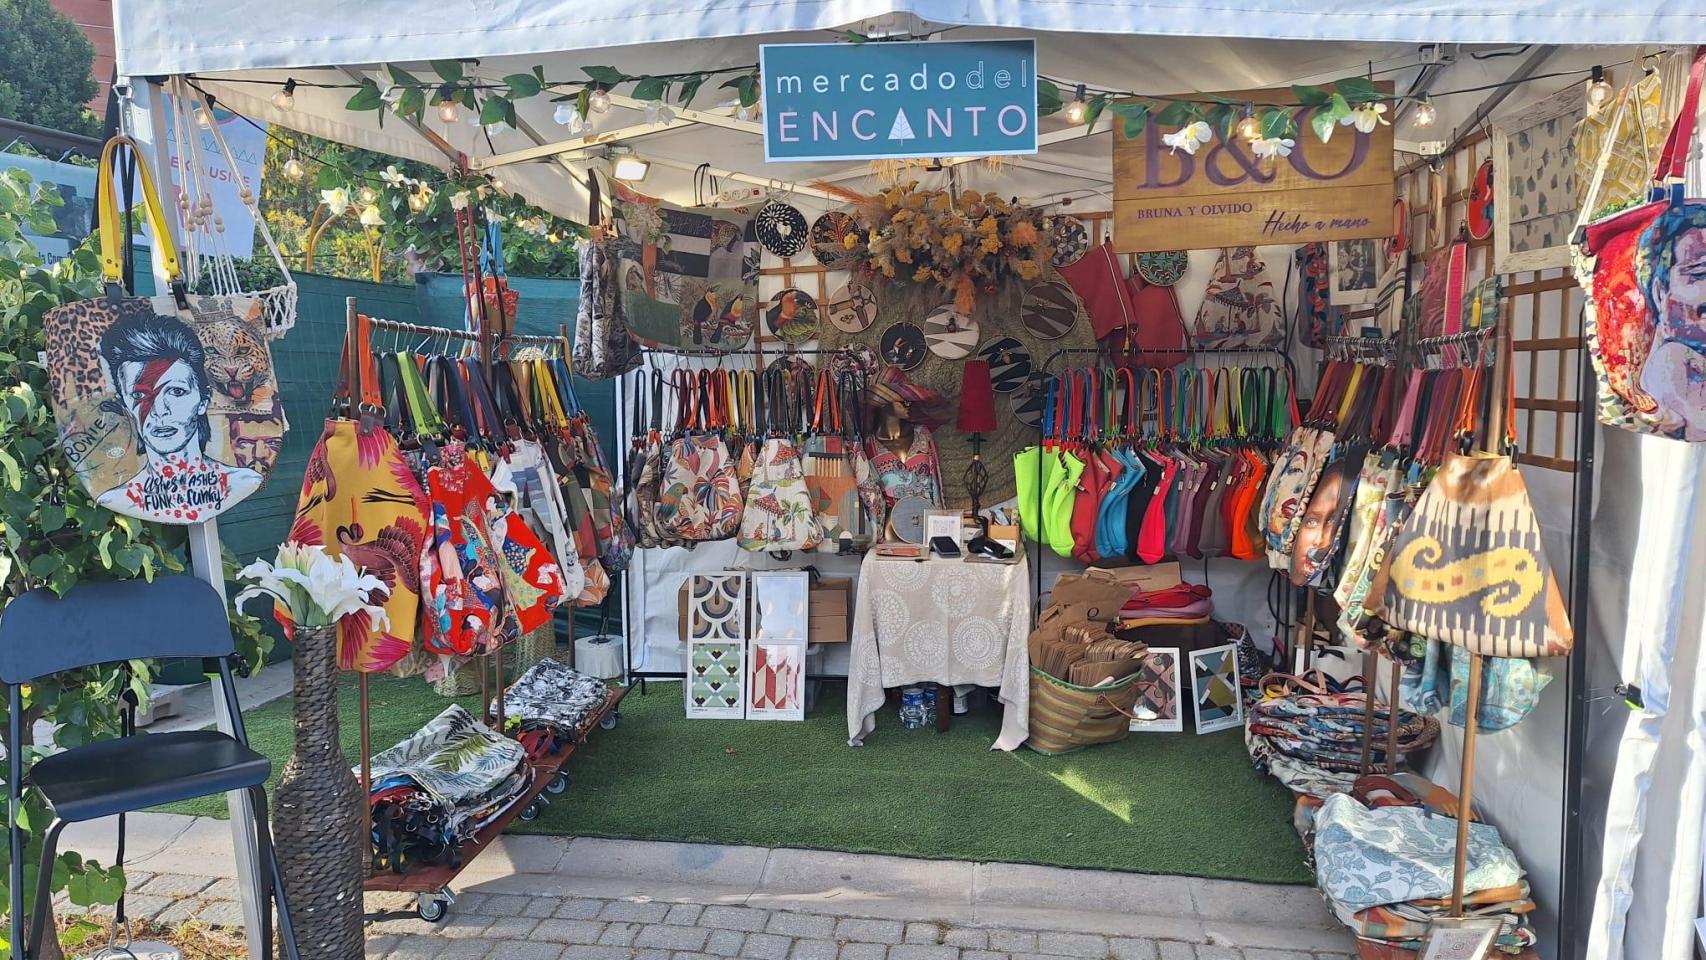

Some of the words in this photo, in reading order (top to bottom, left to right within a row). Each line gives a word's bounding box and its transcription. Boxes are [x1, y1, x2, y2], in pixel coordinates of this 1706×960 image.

[1137, 207, 1182, 219] BRUNA
[1187, 206, 1199, 217] Y
[1201, 203, 1253, 216] OLVIDO
[1262, 209, 1310, 238] Hecho
[1314, 220, 1324, 231] a
[1330, 217, 1372, 230] mano
[64, 418, 107, 463] BOWIE
[188, 471, 218, 487] ASHES
[144, 494, 177, 511] FUNK
